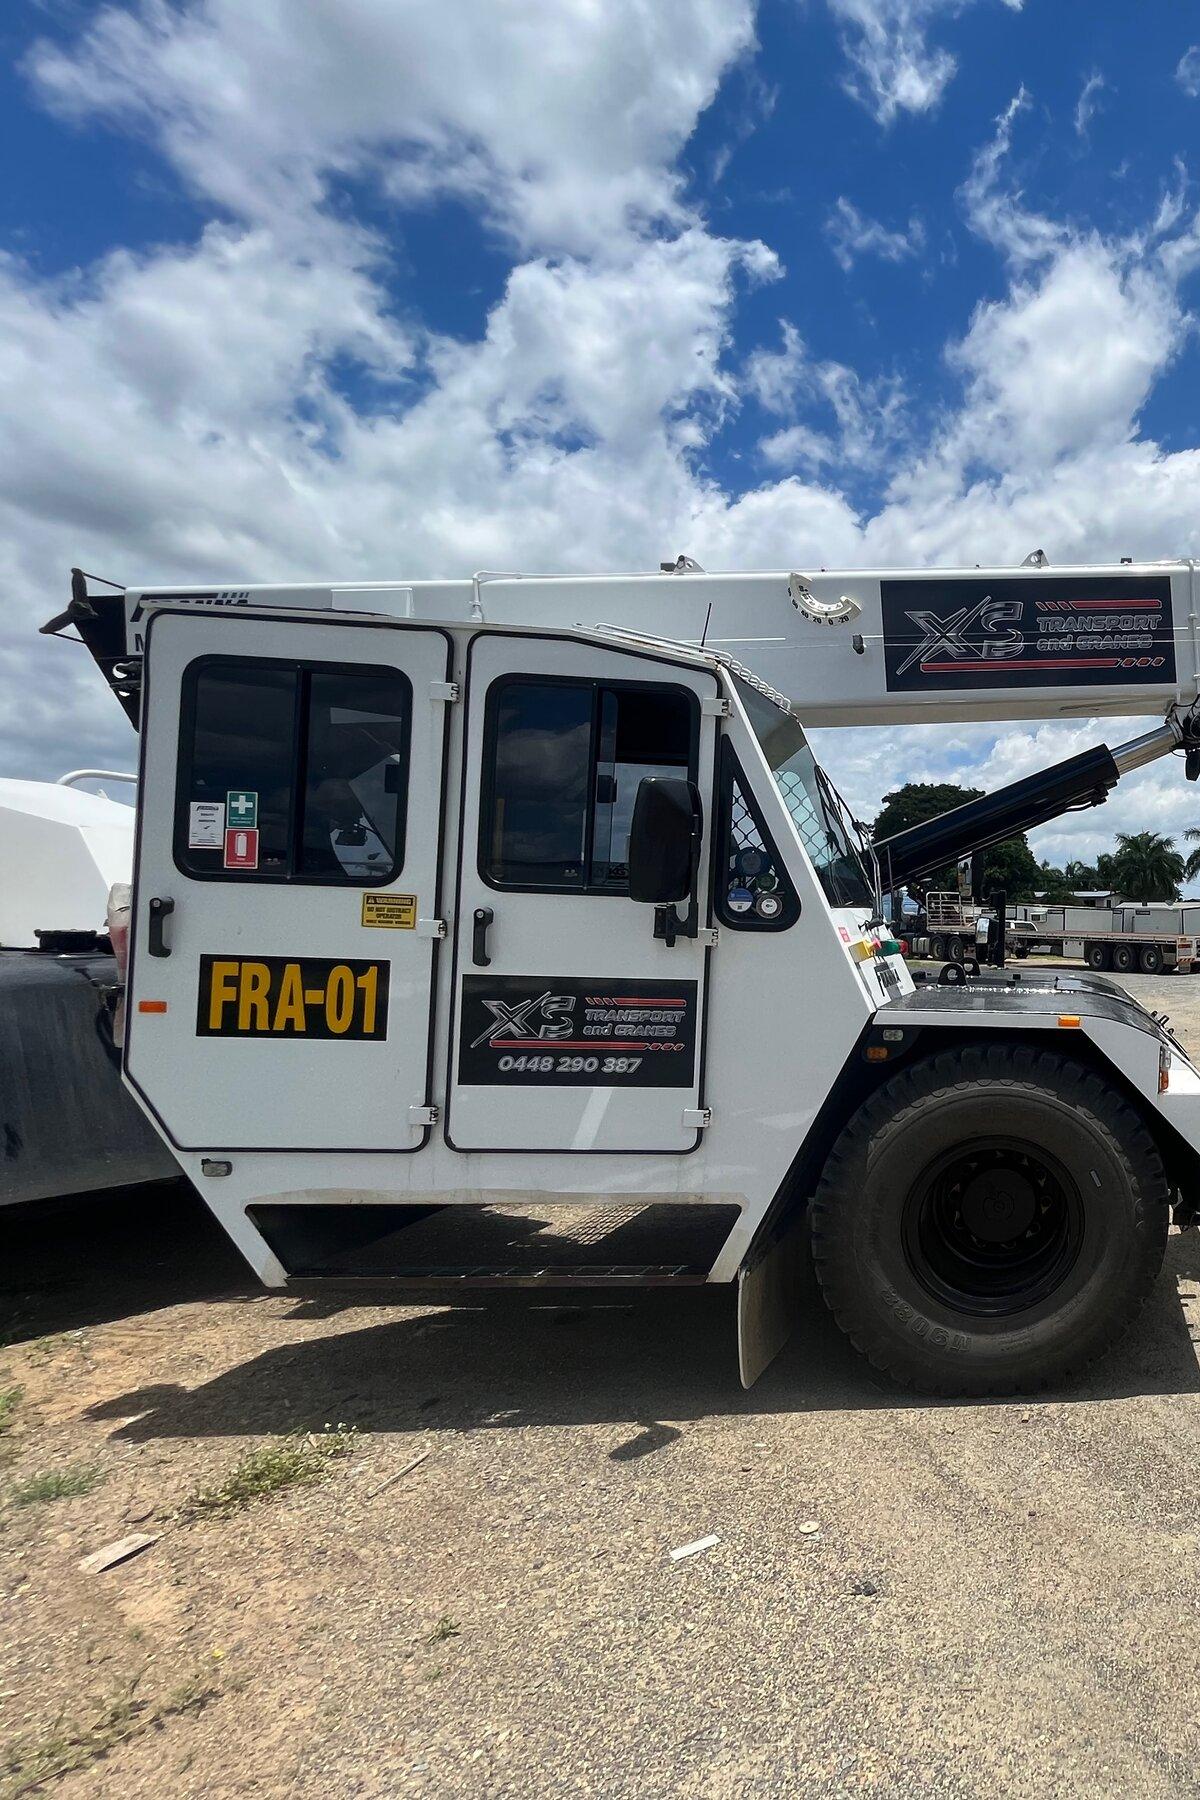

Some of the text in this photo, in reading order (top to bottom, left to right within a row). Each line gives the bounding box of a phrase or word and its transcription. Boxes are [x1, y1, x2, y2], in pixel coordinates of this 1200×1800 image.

[1036, 615, 1163, 633] TRANSPORT
[896, 596, 1024, 675] XS
[1036, 634, 1153, 650] and CRANES
[209, 961, 378, 1034] FRA-01
[470, 991, 576, 1048] XS
[585, 1009, 686, 1022] TRANSPORT
[583, 1024, 676, 1037] and CRANES
[498, 1055, 642, 1073] 0448 290 387
